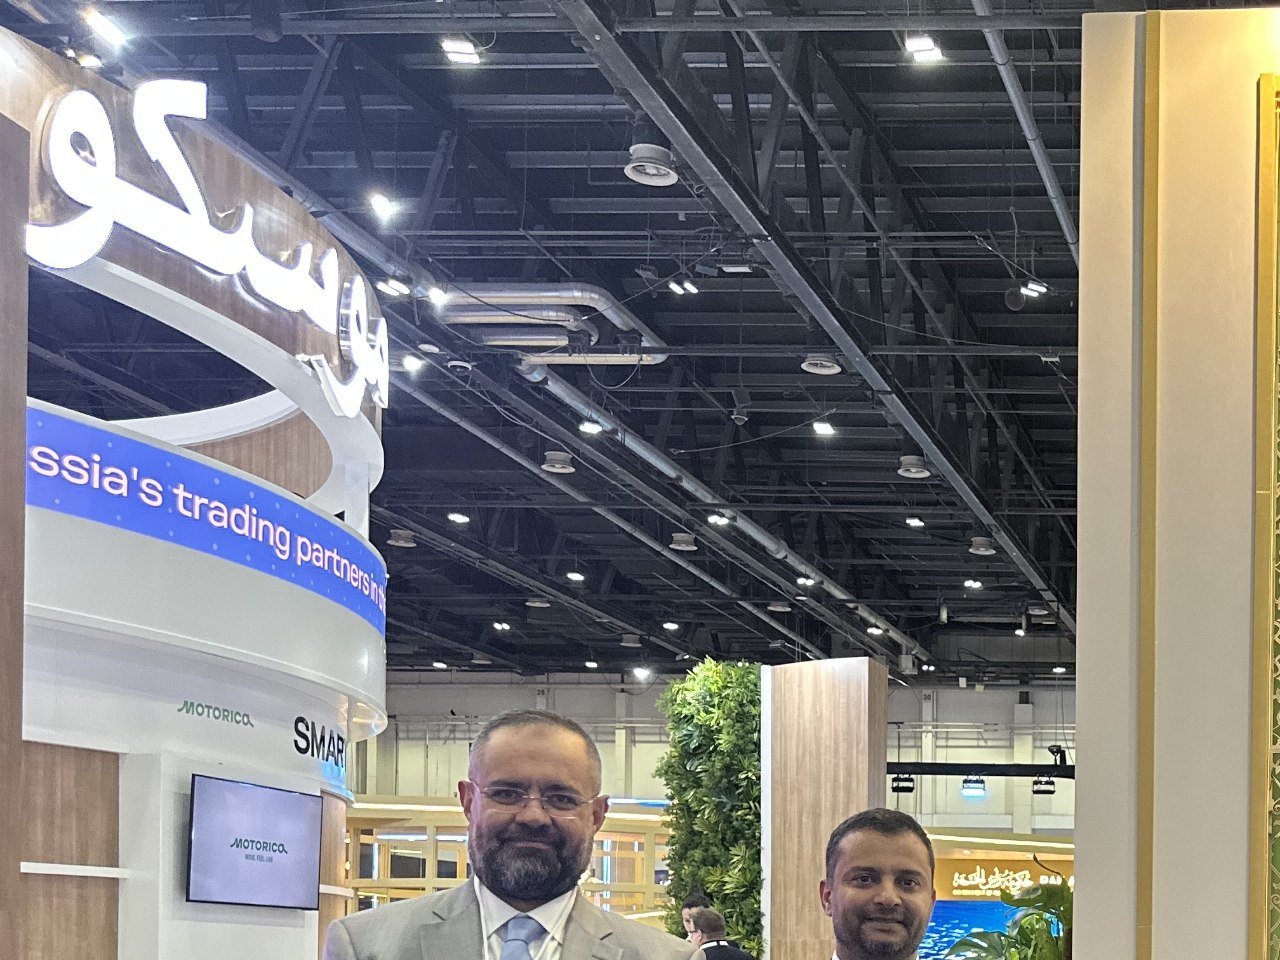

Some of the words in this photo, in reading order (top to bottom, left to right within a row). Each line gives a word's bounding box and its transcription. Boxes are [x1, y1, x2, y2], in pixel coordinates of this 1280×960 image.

[29, 446, 164, 508] ssia's
[172, 482, 290, 561] trading
[297, 535, 370, 596] partners
